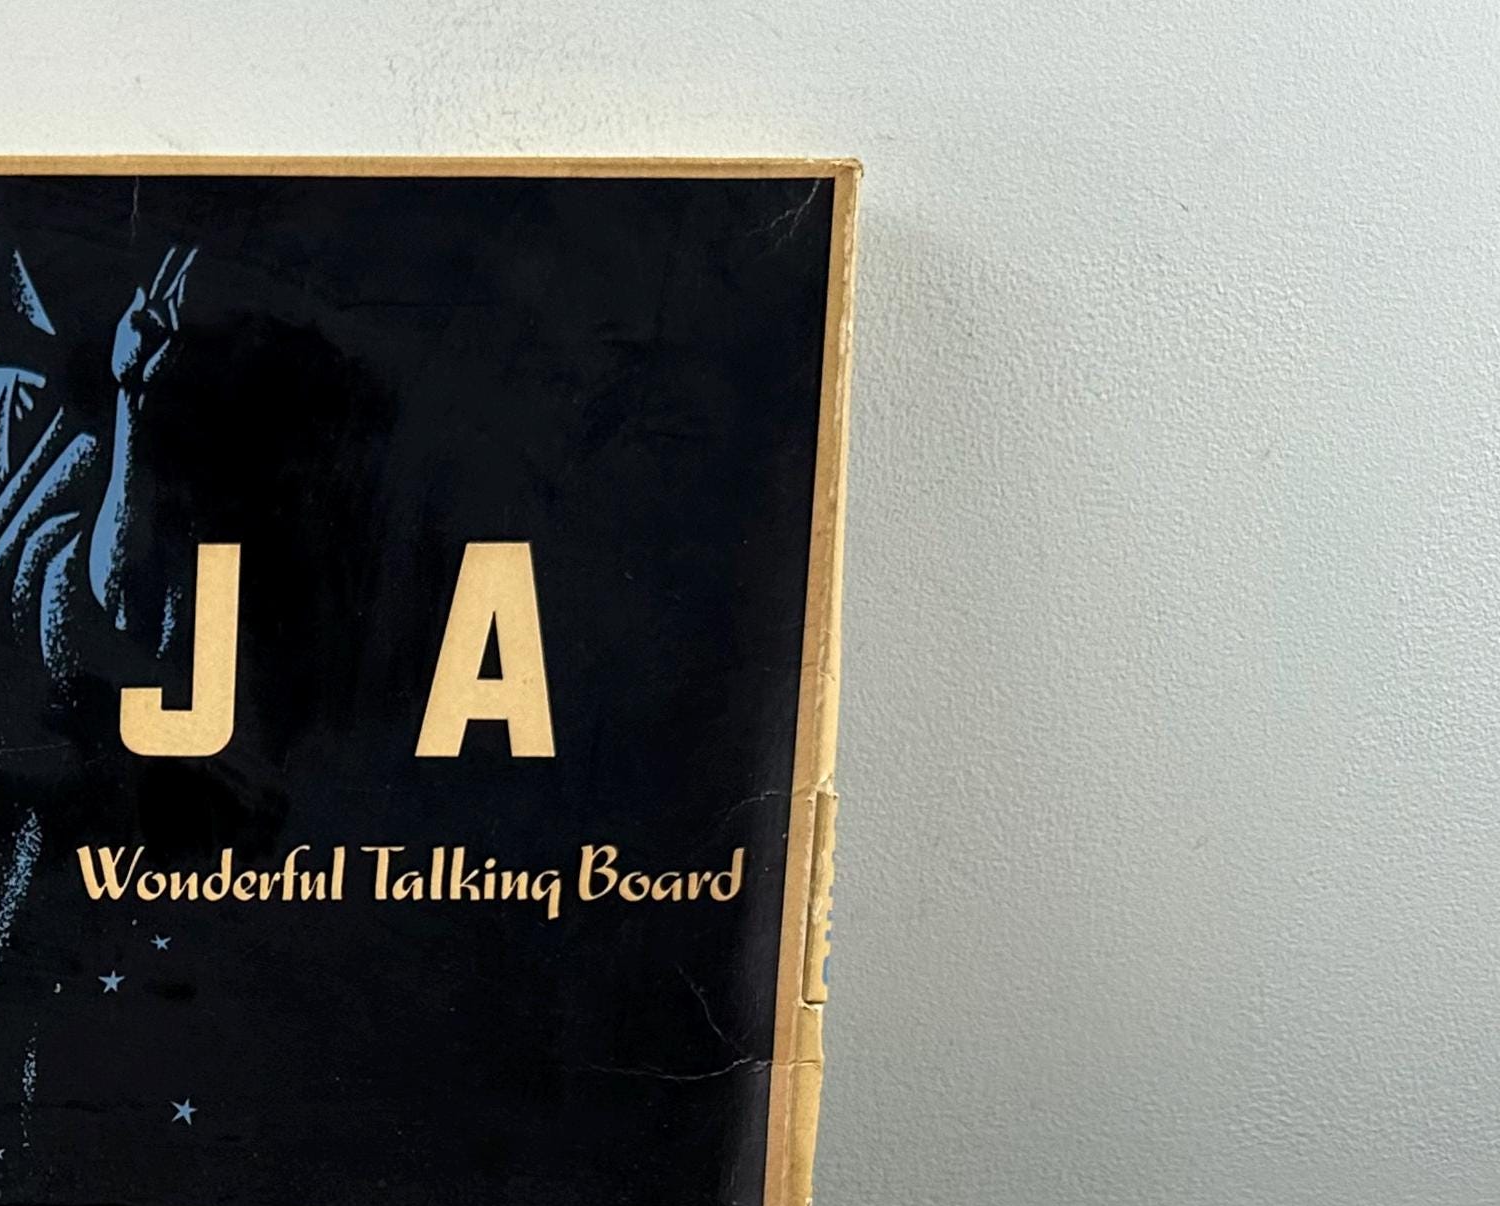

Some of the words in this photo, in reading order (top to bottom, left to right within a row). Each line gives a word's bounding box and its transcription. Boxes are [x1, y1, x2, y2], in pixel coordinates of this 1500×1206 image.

[75, 844, 346, 903] Wonderful
[360, 844, 563, 920] Talking
[577, 844, 746, 903] Board
